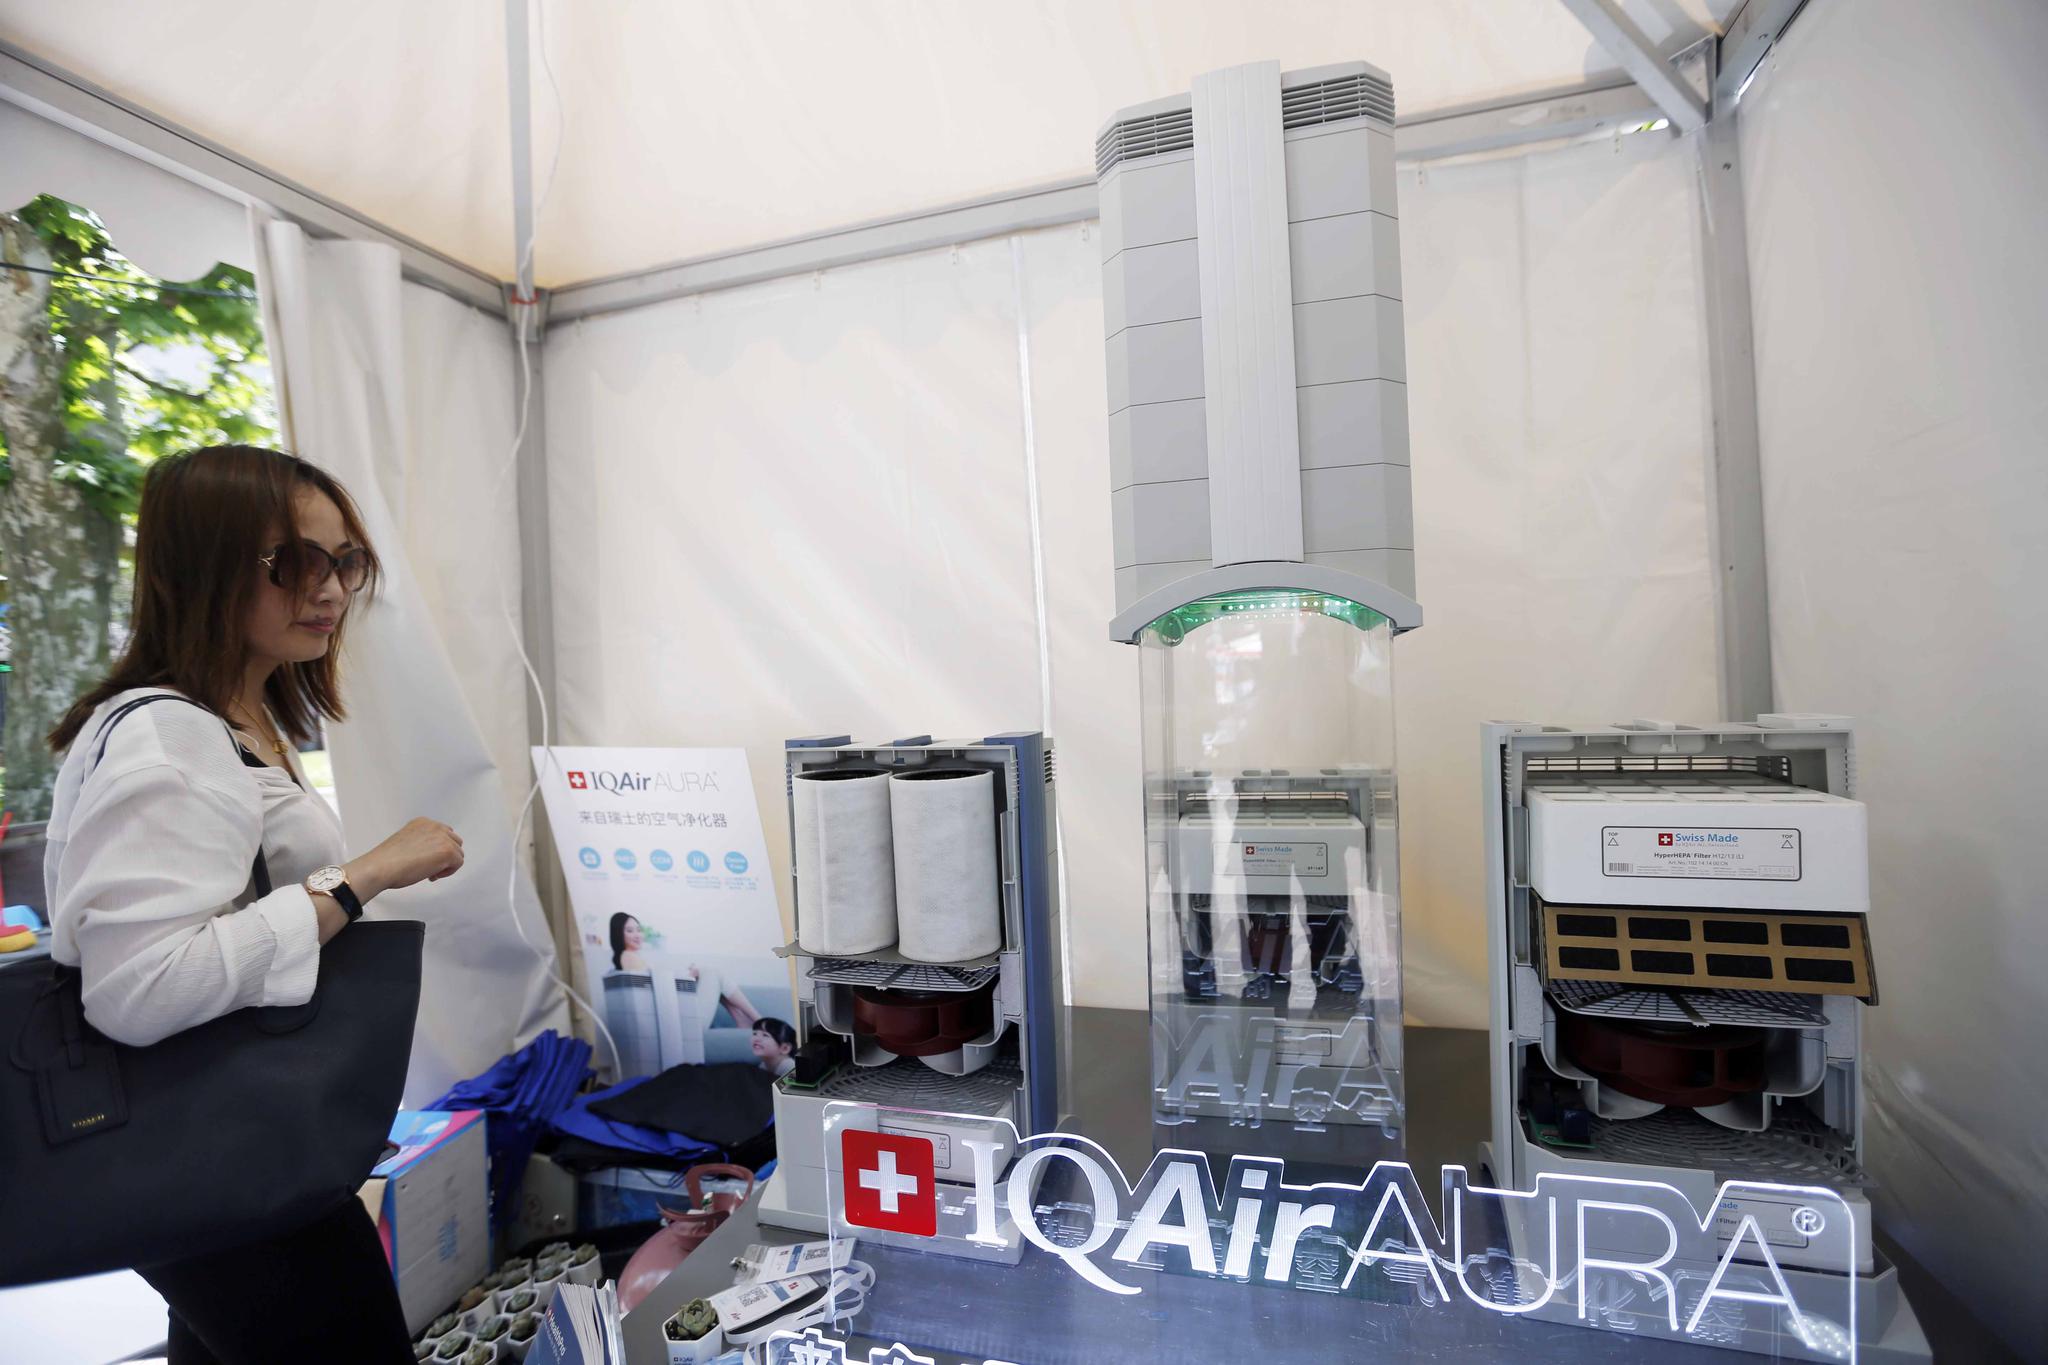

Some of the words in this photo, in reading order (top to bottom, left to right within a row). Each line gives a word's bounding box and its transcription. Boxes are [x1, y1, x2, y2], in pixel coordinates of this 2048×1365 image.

[579, 811, 728, 828] 来自瑞士的空气净化器
[1675, 833, 1705, 842] Swiss
[1707, 834, 1739, 843] Made
